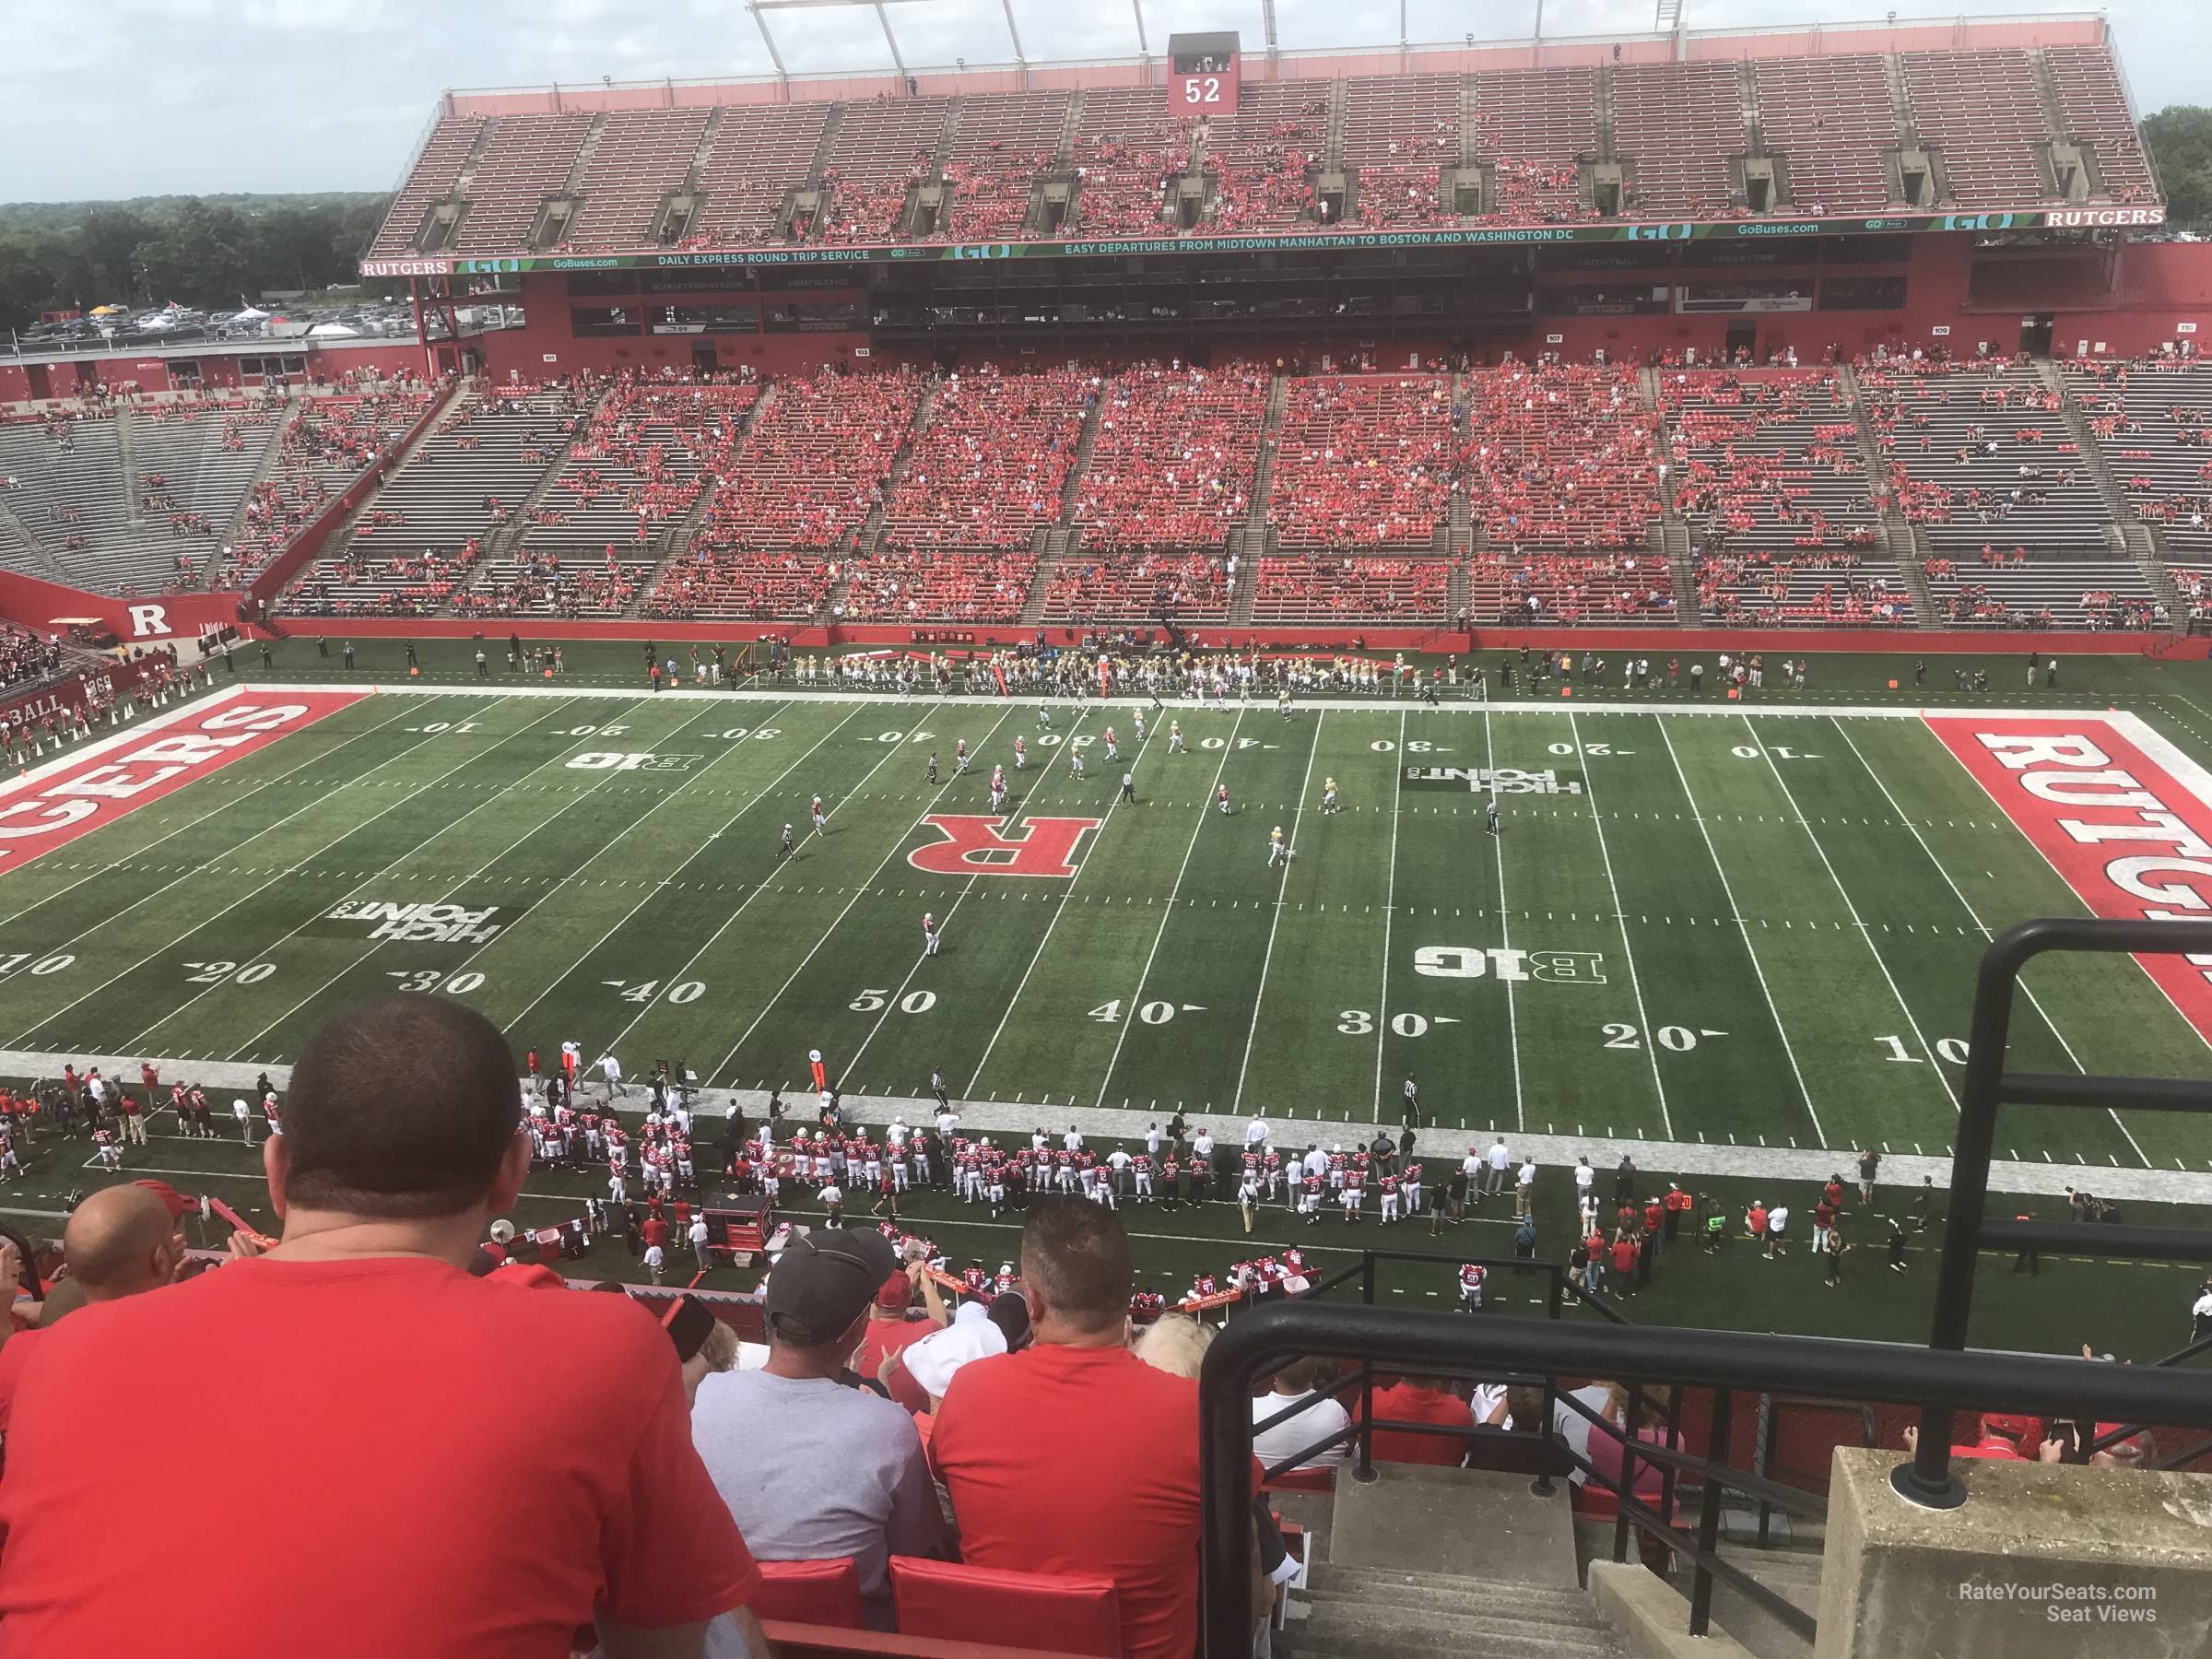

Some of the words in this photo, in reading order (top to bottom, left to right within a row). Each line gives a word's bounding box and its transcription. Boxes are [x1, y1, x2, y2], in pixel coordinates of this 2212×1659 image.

[1185, 77, 1220, 103] 52
[1865, 220, 1882, 229] GO
[1945, 214, 2013, 230] GO
[2047, 209, 2163, 227] RUTGERS
[1629, 224, 1692, 241] GO
[1738, 224, 1818, 235] GoBuses.com
[1065, 244, 1095, 254] EASY
[1100, 241, 1176, 253] DEPARTURES
[1180, 240, 1213, 251] FROM
[1218, 238, 1277, 249] MIDTOWN
[1279, 235, 1356, 248] MANHATTAN
[1359, 235, 1376, 245] TO
[1380, 233, 1430, 244] BOSTON
[1435, 232, 1462, 243] AND
[1466, 230, 1552, 242] WASHINGTON
[1557, 229, 1574, 240] DC
[658, 255, 690, 265] DAILY
[694, 253, 744, 265] EXPRESS
[747, 253, 788, 263] ROUND
[793, 252, 818, 262] TRIP
[821, 251, 869, 261] SERVICE
[954, 245, 1010, 259] GO
[364, 262, 448, 276] RUTGERS
[468, 259, 520, 274] GO
[554, 258, 618, 268] GoBuses.com
[129, 604, 172, 637] R
[1420, 767, 1556, 782] POINT
[1470, 780, 1582, 794] HIGH
[907, 814, 1104, 877] R
[339, 901, 500, 924] POINT
[367, 920, 502, 944] HIGH
[184, 961, 277, 984] 20
[398, 971, 486, 994] 30
[619, 980, 707, 1004] 40
[848, 988, 937, 1014] 50
[1087, 999, 1175, 1025] 40
[1336, 1010, 1428, 1037] 30
[1602, 1023, 1697, 1052] 20
[914, 1144, 924, 1153] 13
[1136, 1163, 1147, 1171] 23
[1245, 1159, 1256, 1168] 20
[1333, 1162, 1343, 1171] 22
[1310, 1183, 1320, 1193] 57
[971, 1275, 977, 1286] 9
[1466, 1274, 1479, 1284] 50
[1203, 1283, 1214, 1294] 97
